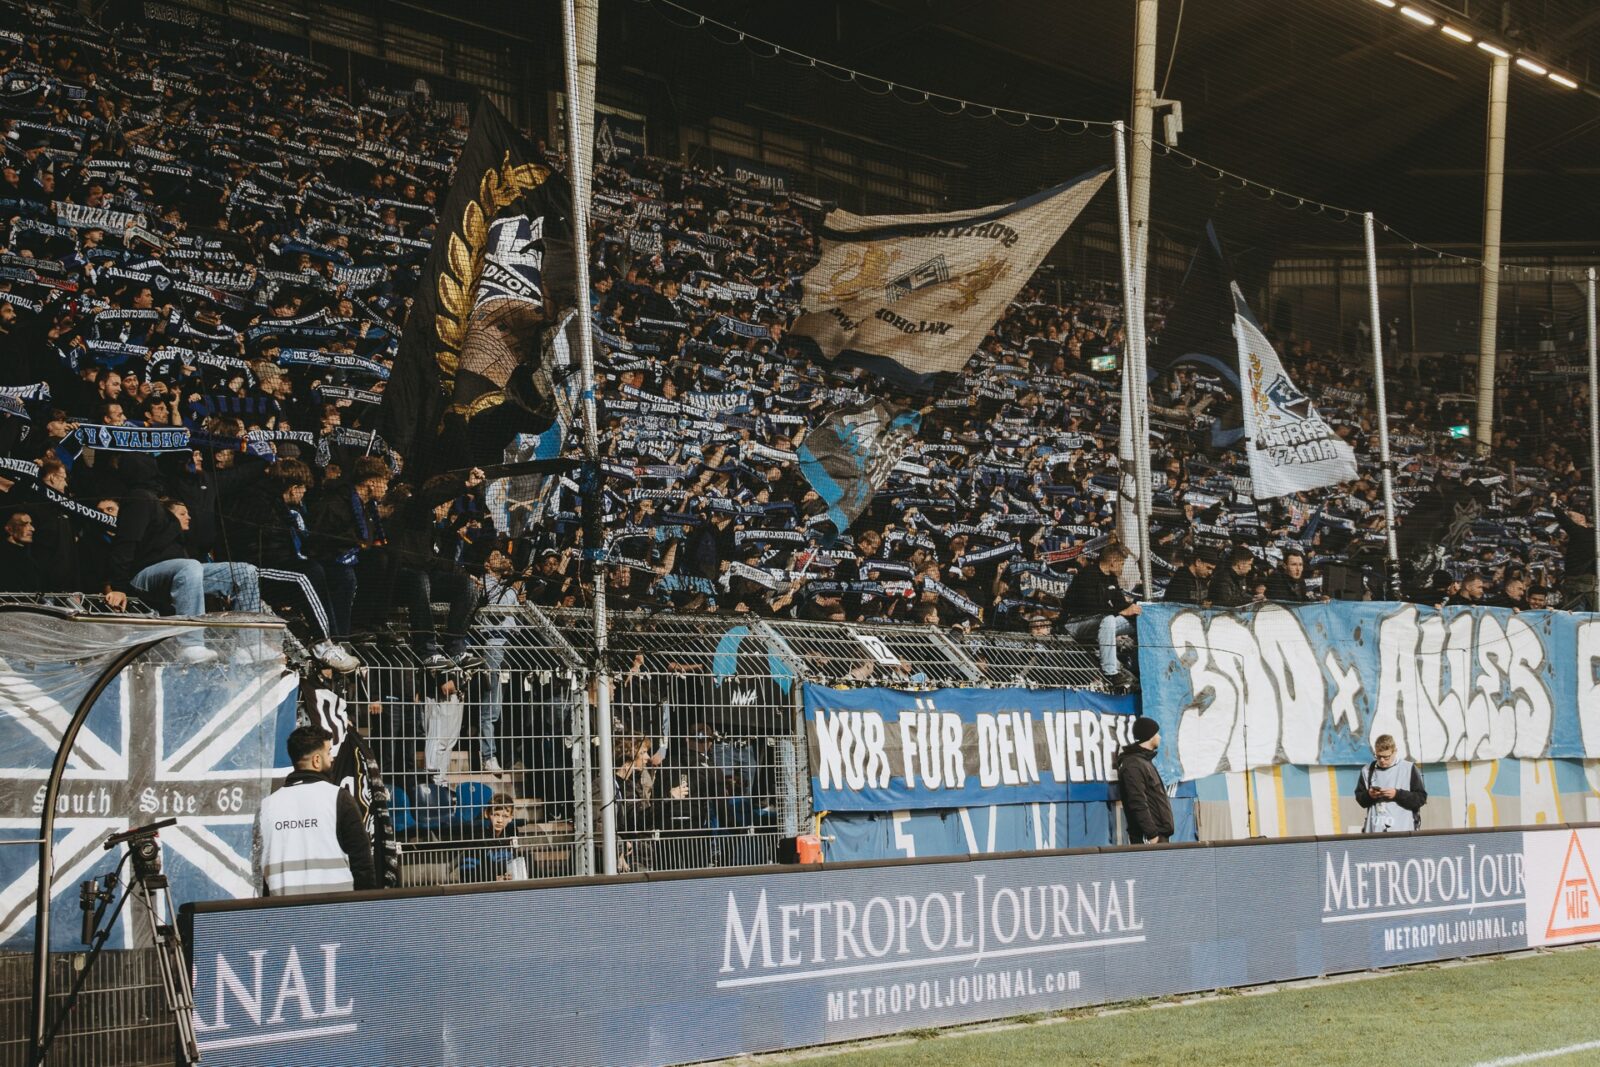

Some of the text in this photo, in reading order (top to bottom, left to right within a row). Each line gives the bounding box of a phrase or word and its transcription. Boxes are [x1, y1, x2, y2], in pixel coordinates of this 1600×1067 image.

[293, 351, 308, 360] DIE
[333, 355, 356, 366] SIND
[113, 430, 190, 448] WALDHOF
[0, 457, 40, 478] ANNHEIM
[864, 640, 895, 661] 12
[1369, 605, 1554, 764] ALLES
[815, 710, 890, 791] NUR
[899, 698, 966, 789] FÜR
[977, 711, 1040, 788] DEN
[138, 787, 198, 814] Side
[216, 786, 243, 812] 68
[275, 818, 318, 831] ORDNER
[1565, 878, 1590, 921] WTG
[827, 970, 1081, 1023] METROPOLJOURNAL.com
